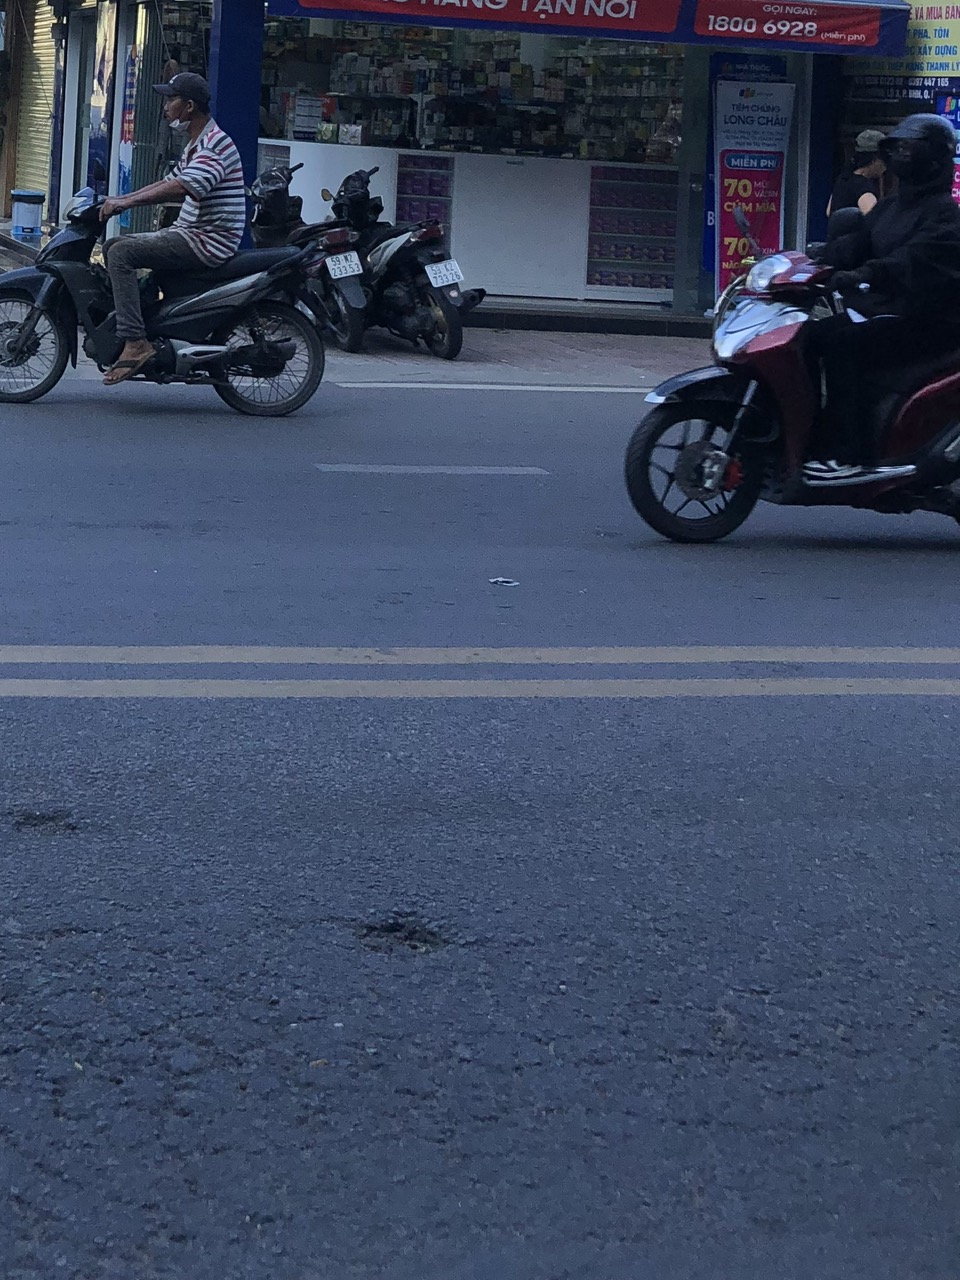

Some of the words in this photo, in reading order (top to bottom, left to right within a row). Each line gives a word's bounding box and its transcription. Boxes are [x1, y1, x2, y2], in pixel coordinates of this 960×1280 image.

[762, 4, 784, 16] GỌI
[785, 6, 818, 17] NGAY:
[926, 5, 943, 20] MUA
[708, 14, 757, 34] 1800
[762, 20, 818, 38] 6928
[926, 61, 950, 72] THANH
[723, 115, 756, 126] LONG
[757, 114, 788, 127] CHÂU
[731, 154, 758, 168] MIỄN
[724, 178, 753, 198] 70
[724, 237, 750, 256] 70
